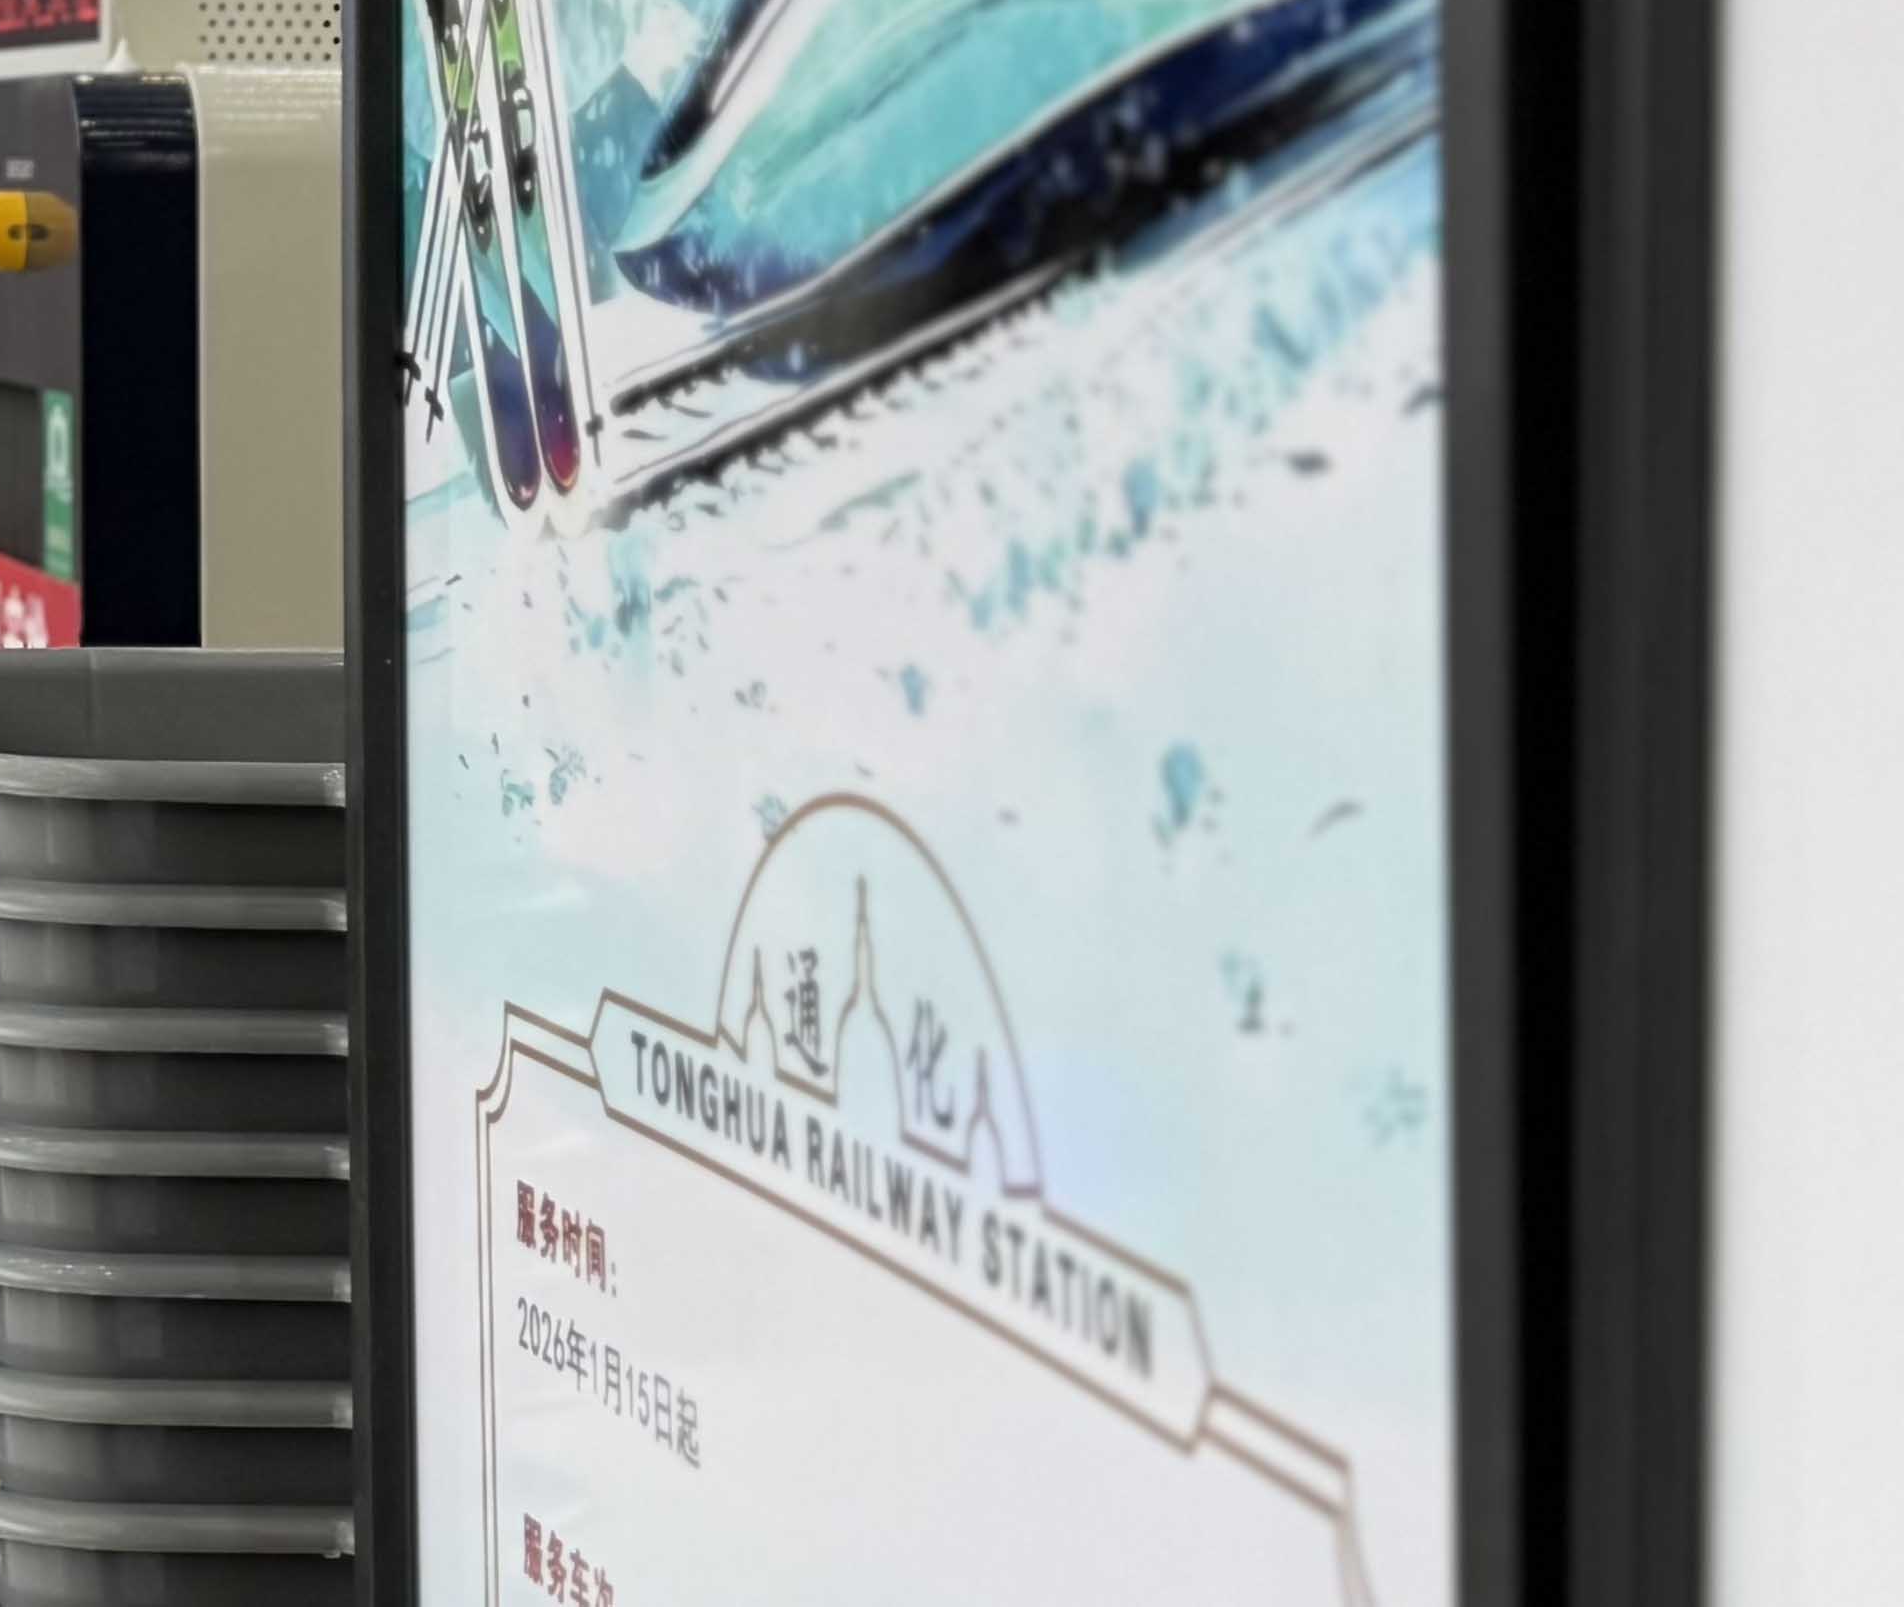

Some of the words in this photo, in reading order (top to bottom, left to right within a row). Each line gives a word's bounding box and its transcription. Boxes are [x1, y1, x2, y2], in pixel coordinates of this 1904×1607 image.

[630, 1030, 792, 1173] TONGHUA
[806, 1127, 965, 1265] RAILWAY
[980, 1211, 1155, 1382] STATION
[518, 1297, 701, 1469] 2026年1月15日起
